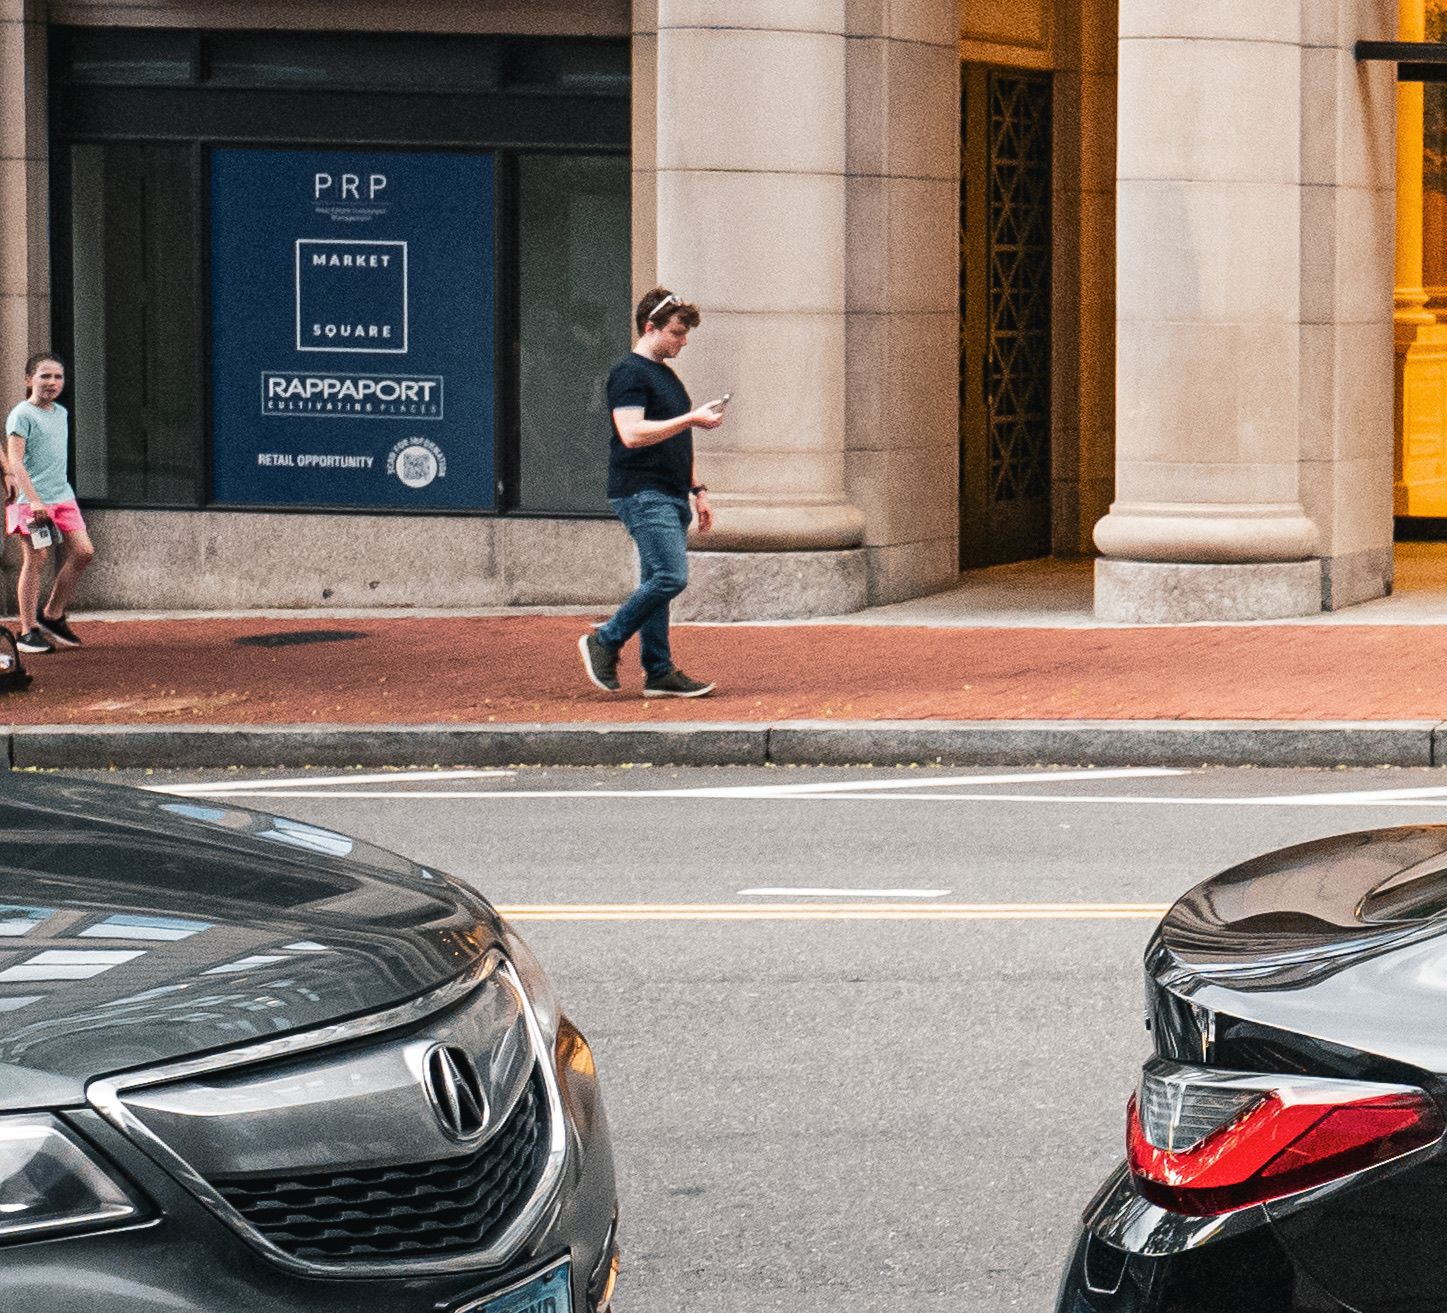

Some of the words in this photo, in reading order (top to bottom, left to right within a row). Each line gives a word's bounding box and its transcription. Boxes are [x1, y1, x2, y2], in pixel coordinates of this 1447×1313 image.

[314, 173, 387, 200] PRP
[312, 254, 391, 267] MARKET
[312, 324, 392, 338] SQUARE
[268, 377, 437, 402] RAPPAPORT
[267, 400, 373, 412] CULTIVATING
[380, 403, 438, 414] PLACES
[257, 453, 295, 467] RETAIL
[297, 455, 374, 469] OPPORTUNITY
